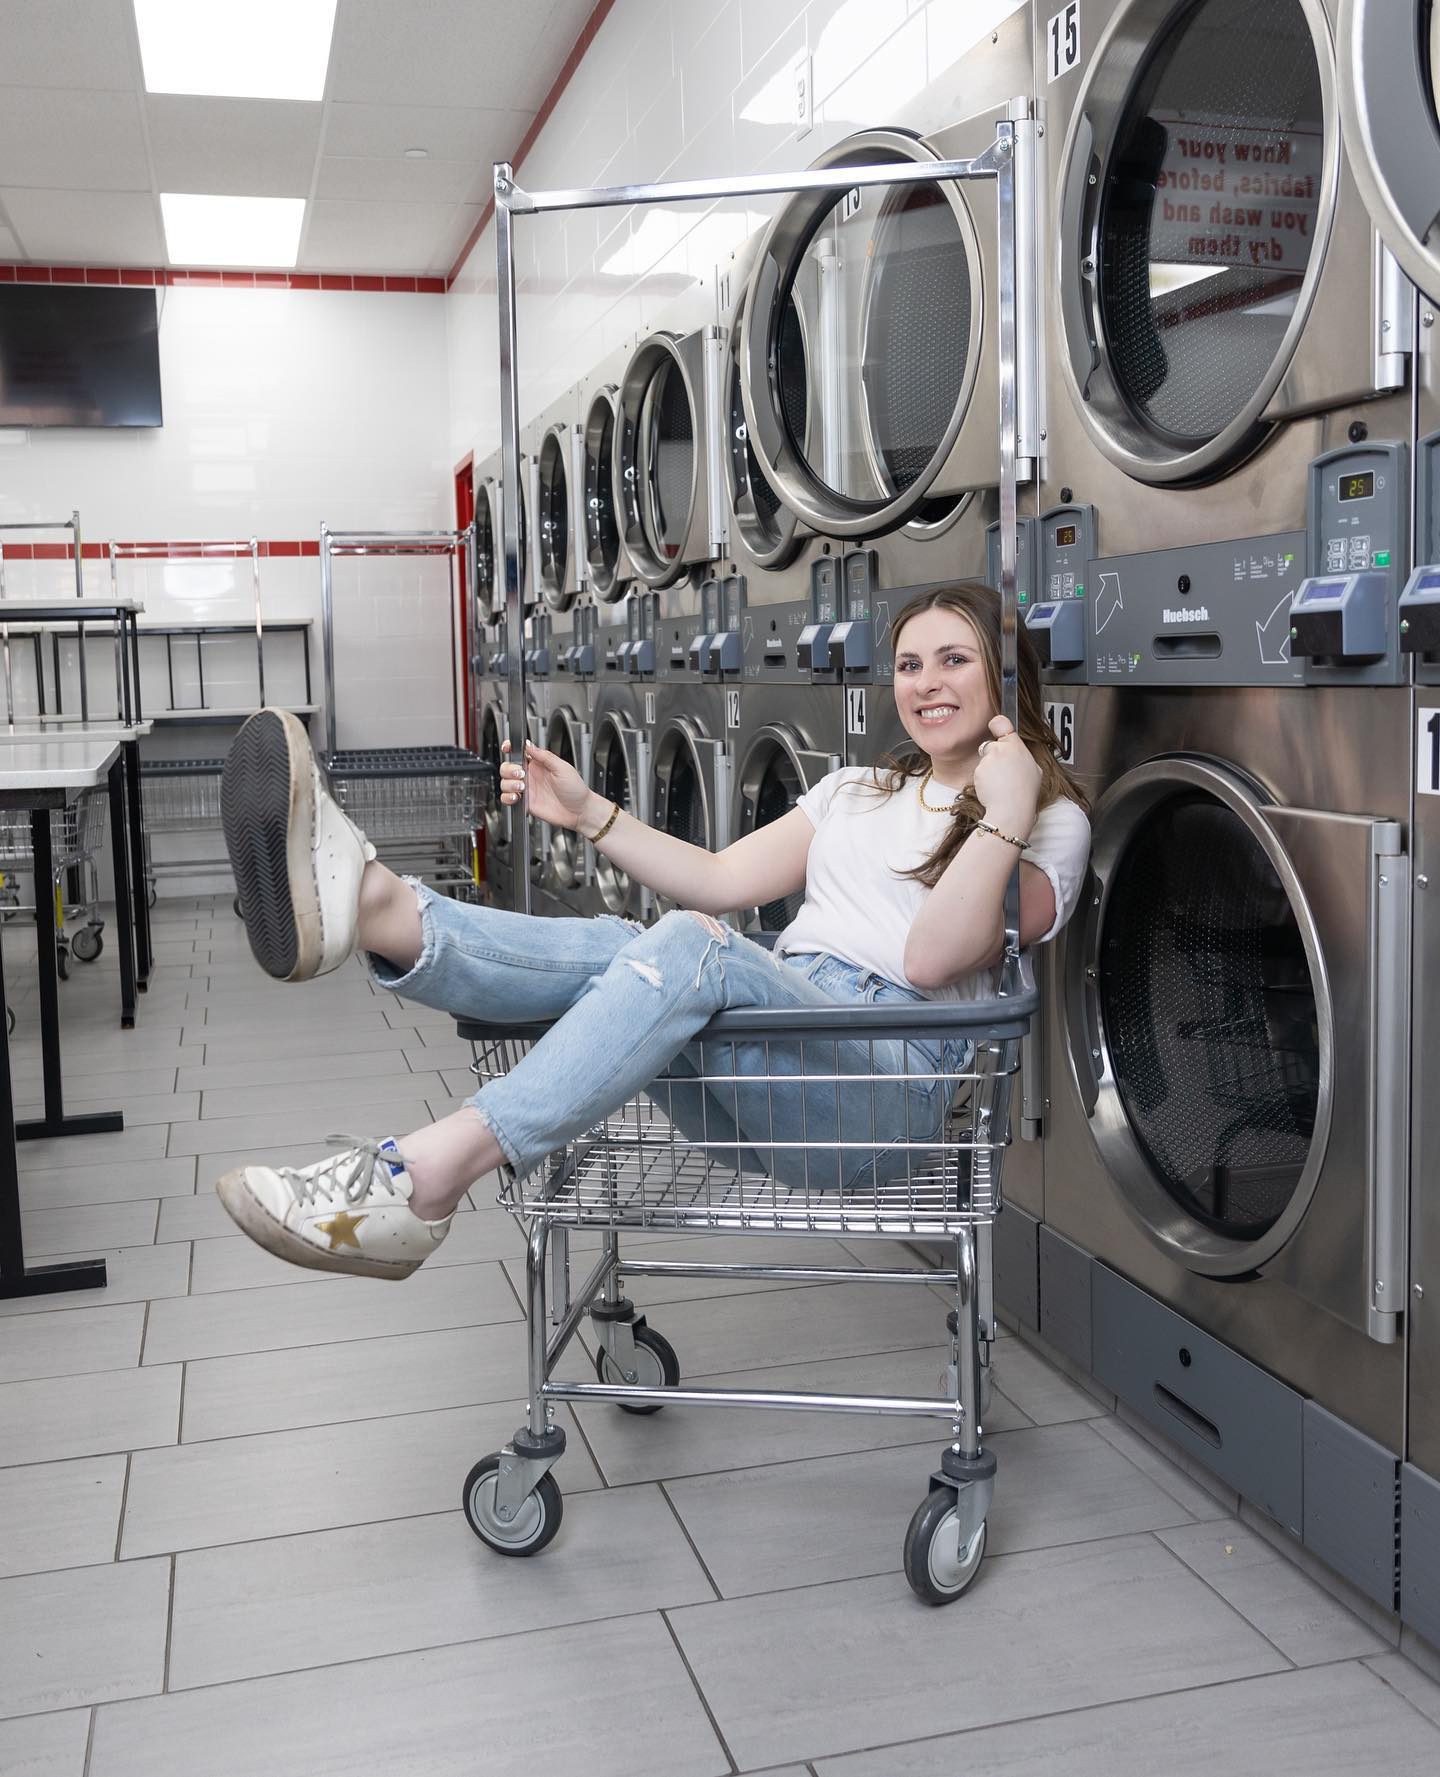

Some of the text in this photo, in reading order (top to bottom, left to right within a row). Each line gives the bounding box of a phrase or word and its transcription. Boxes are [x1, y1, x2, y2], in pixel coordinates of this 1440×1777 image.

[1052, 3, 1077, 76] 15
[1349, 479, 1364, 496] 25
[1163, 606, 1209, 623] Huebsch
[729, 692, 739, 726] 12
[850, 690, 865, 732] 14
